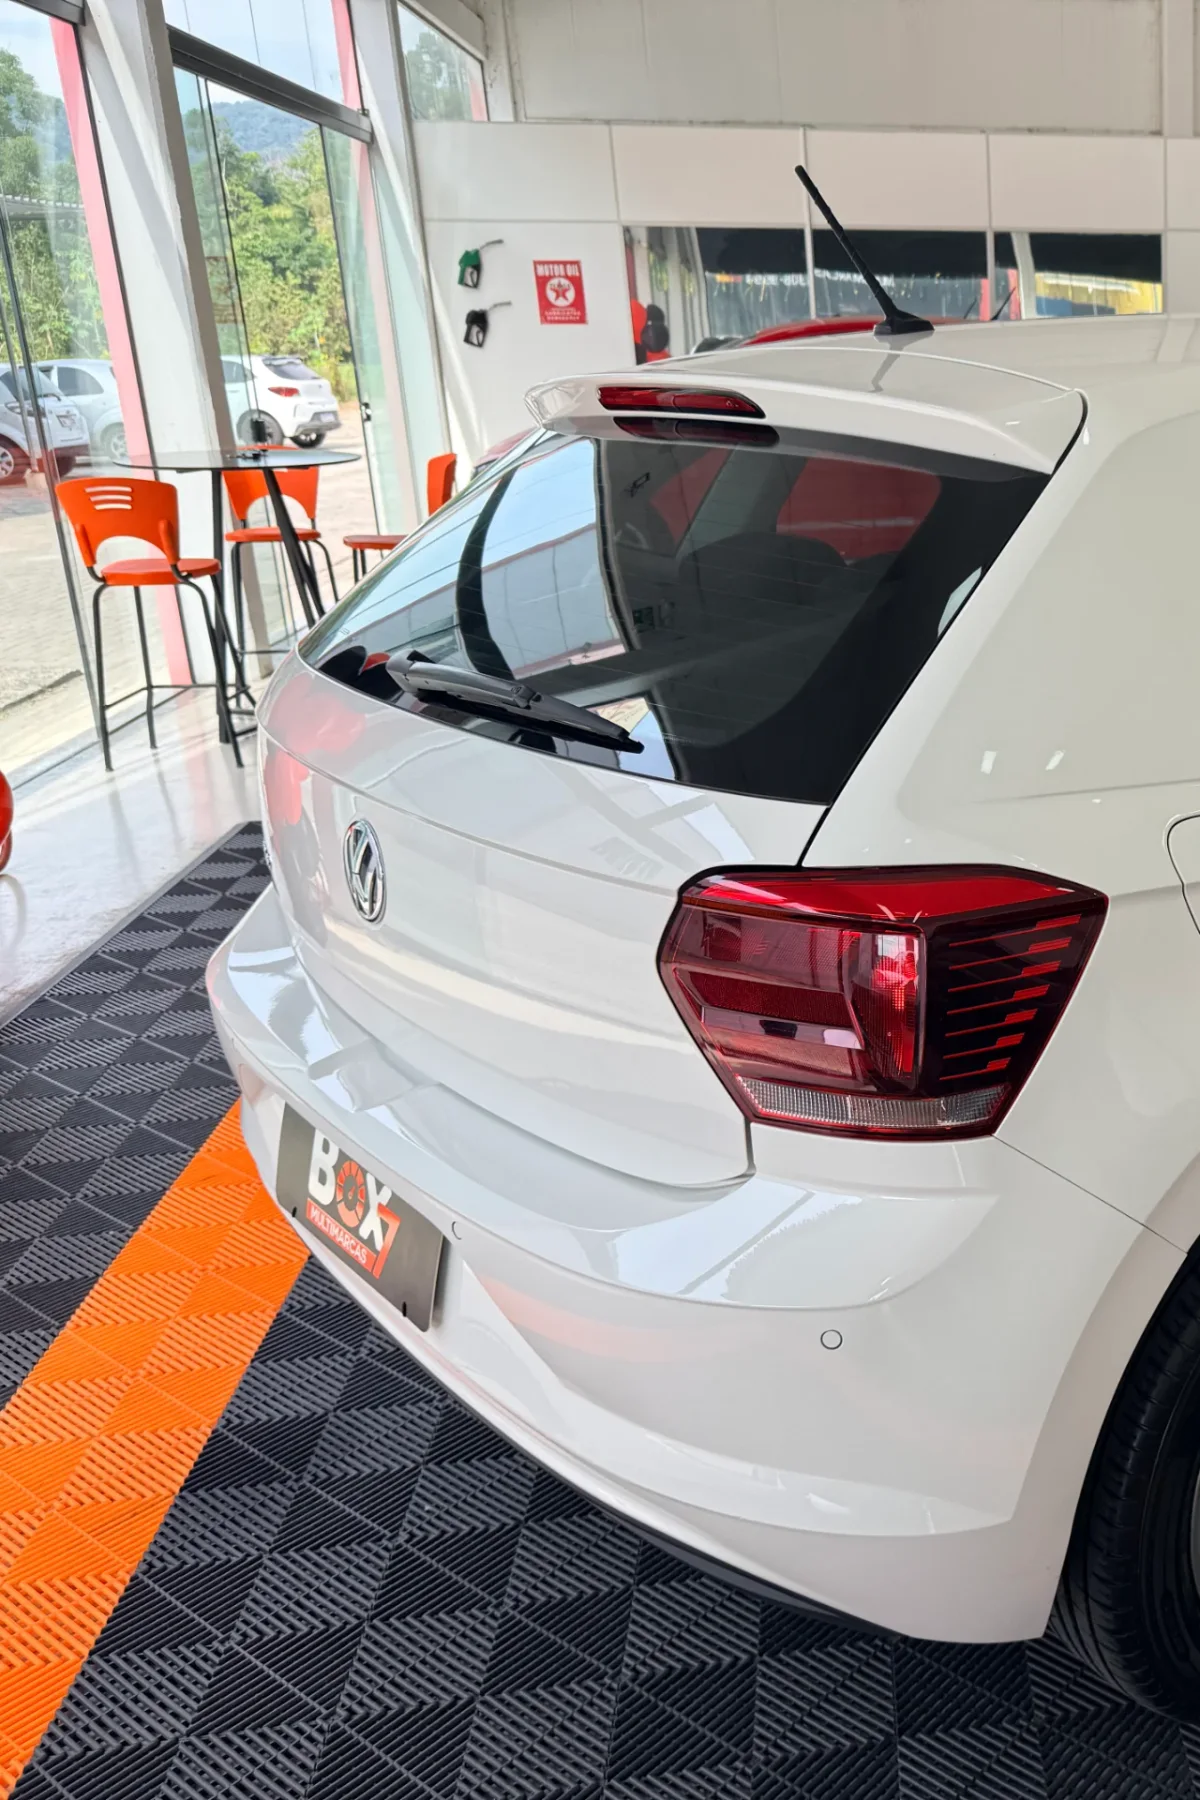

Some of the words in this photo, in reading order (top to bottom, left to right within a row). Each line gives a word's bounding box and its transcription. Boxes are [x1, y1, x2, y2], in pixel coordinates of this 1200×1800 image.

[536, 263, 565, 277] MOTOR
[566, 263, 580, 277] OIL
[311, 1206, 368, 1265] MULTIMARCAS
